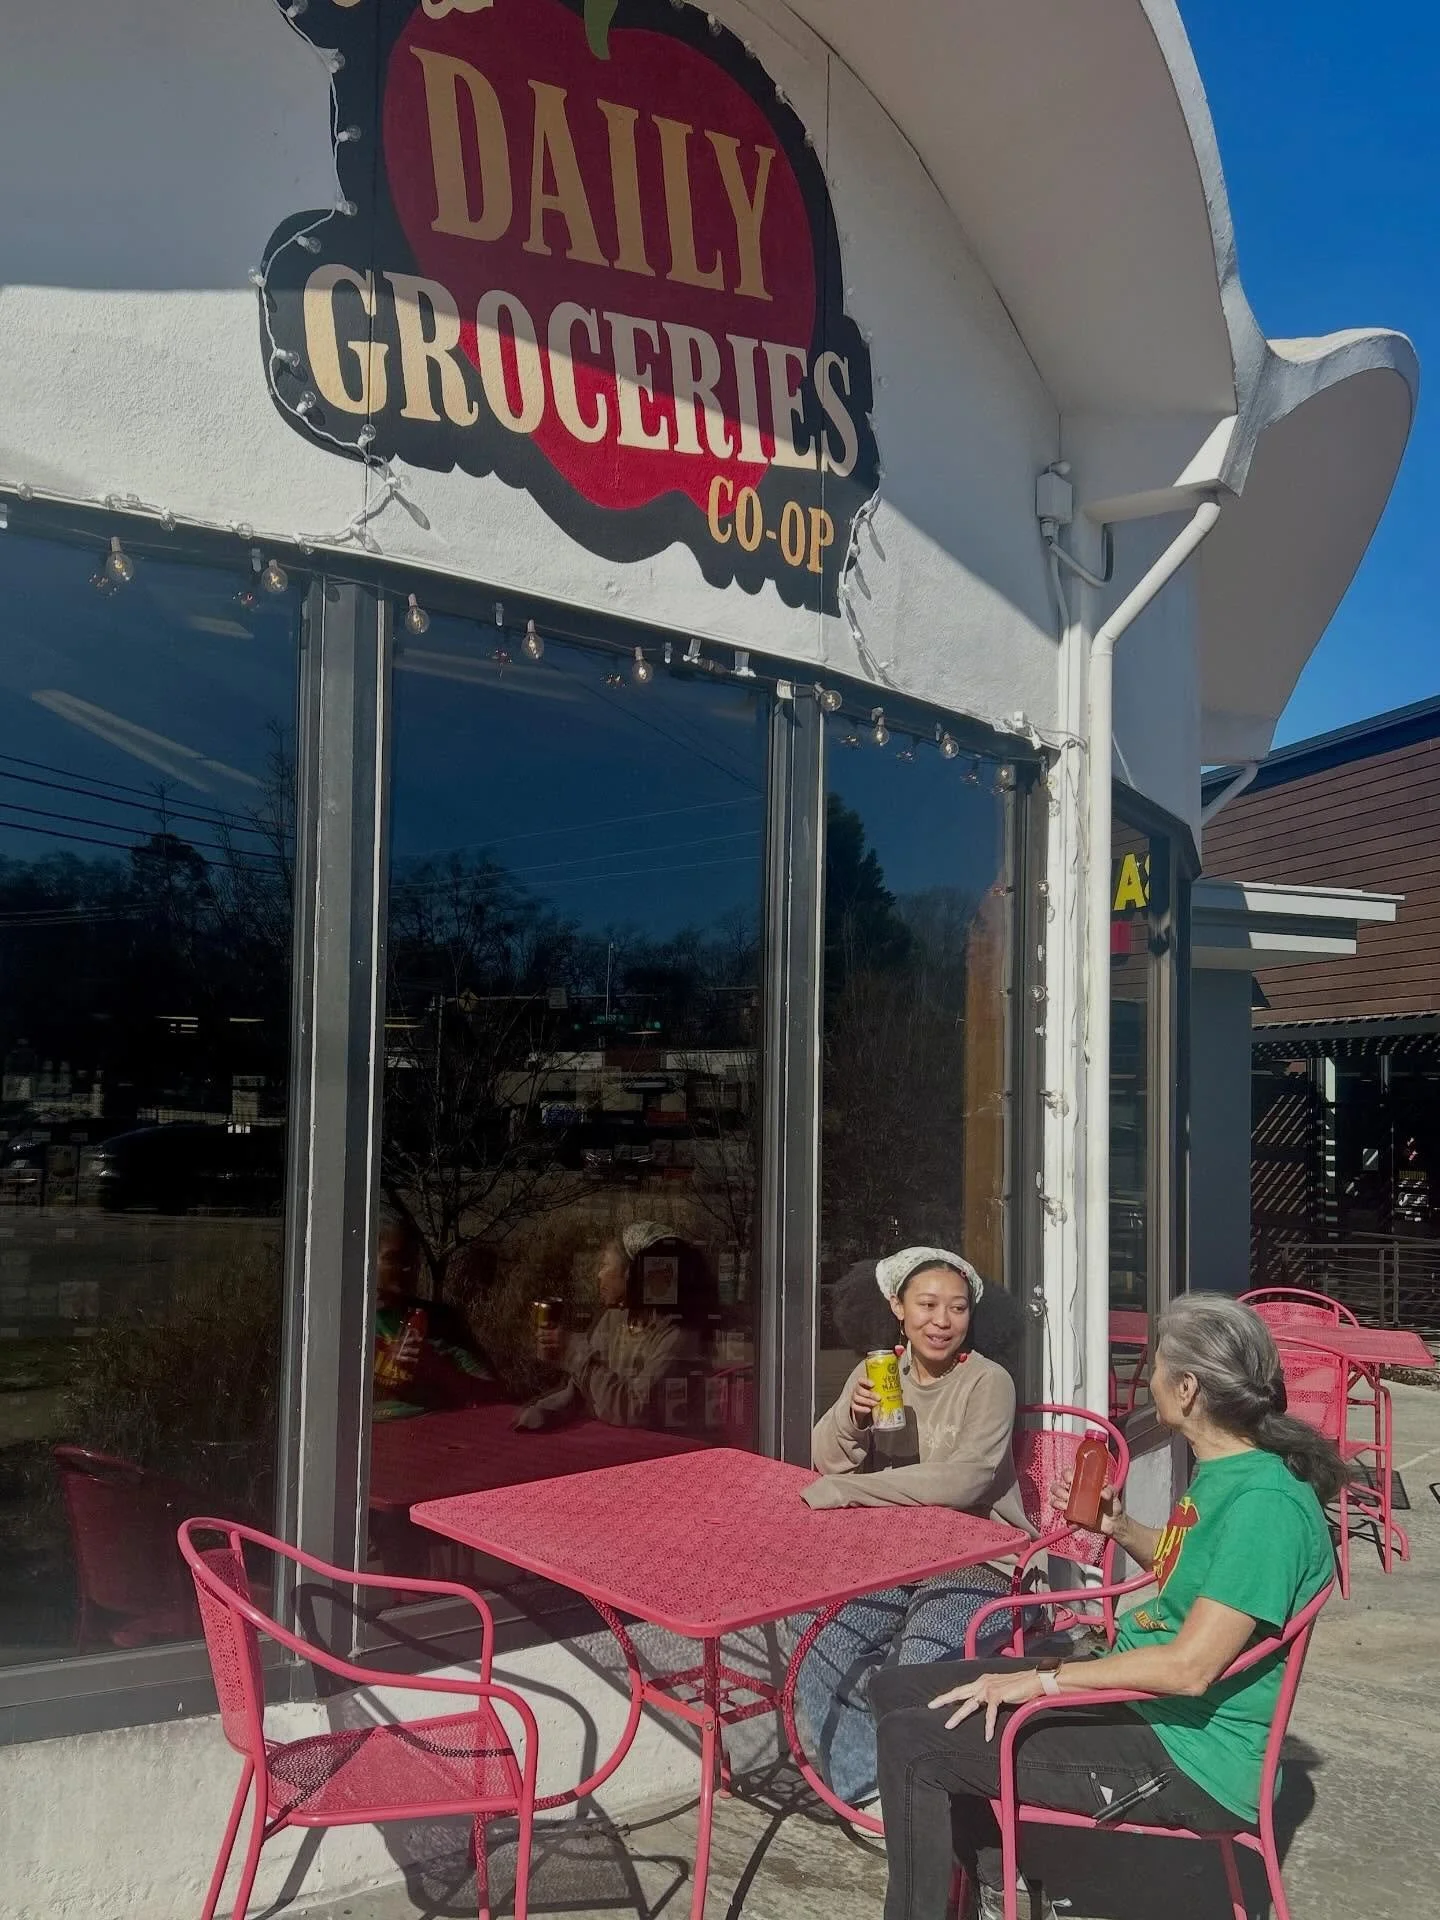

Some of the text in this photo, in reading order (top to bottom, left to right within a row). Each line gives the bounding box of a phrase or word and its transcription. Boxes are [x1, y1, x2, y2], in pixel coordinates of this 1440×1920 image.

[409, 45, 776, 302] DAILY
[303, 263, 859, 478] GROCERIES
[707, 474, 835, 574] CO-OP
